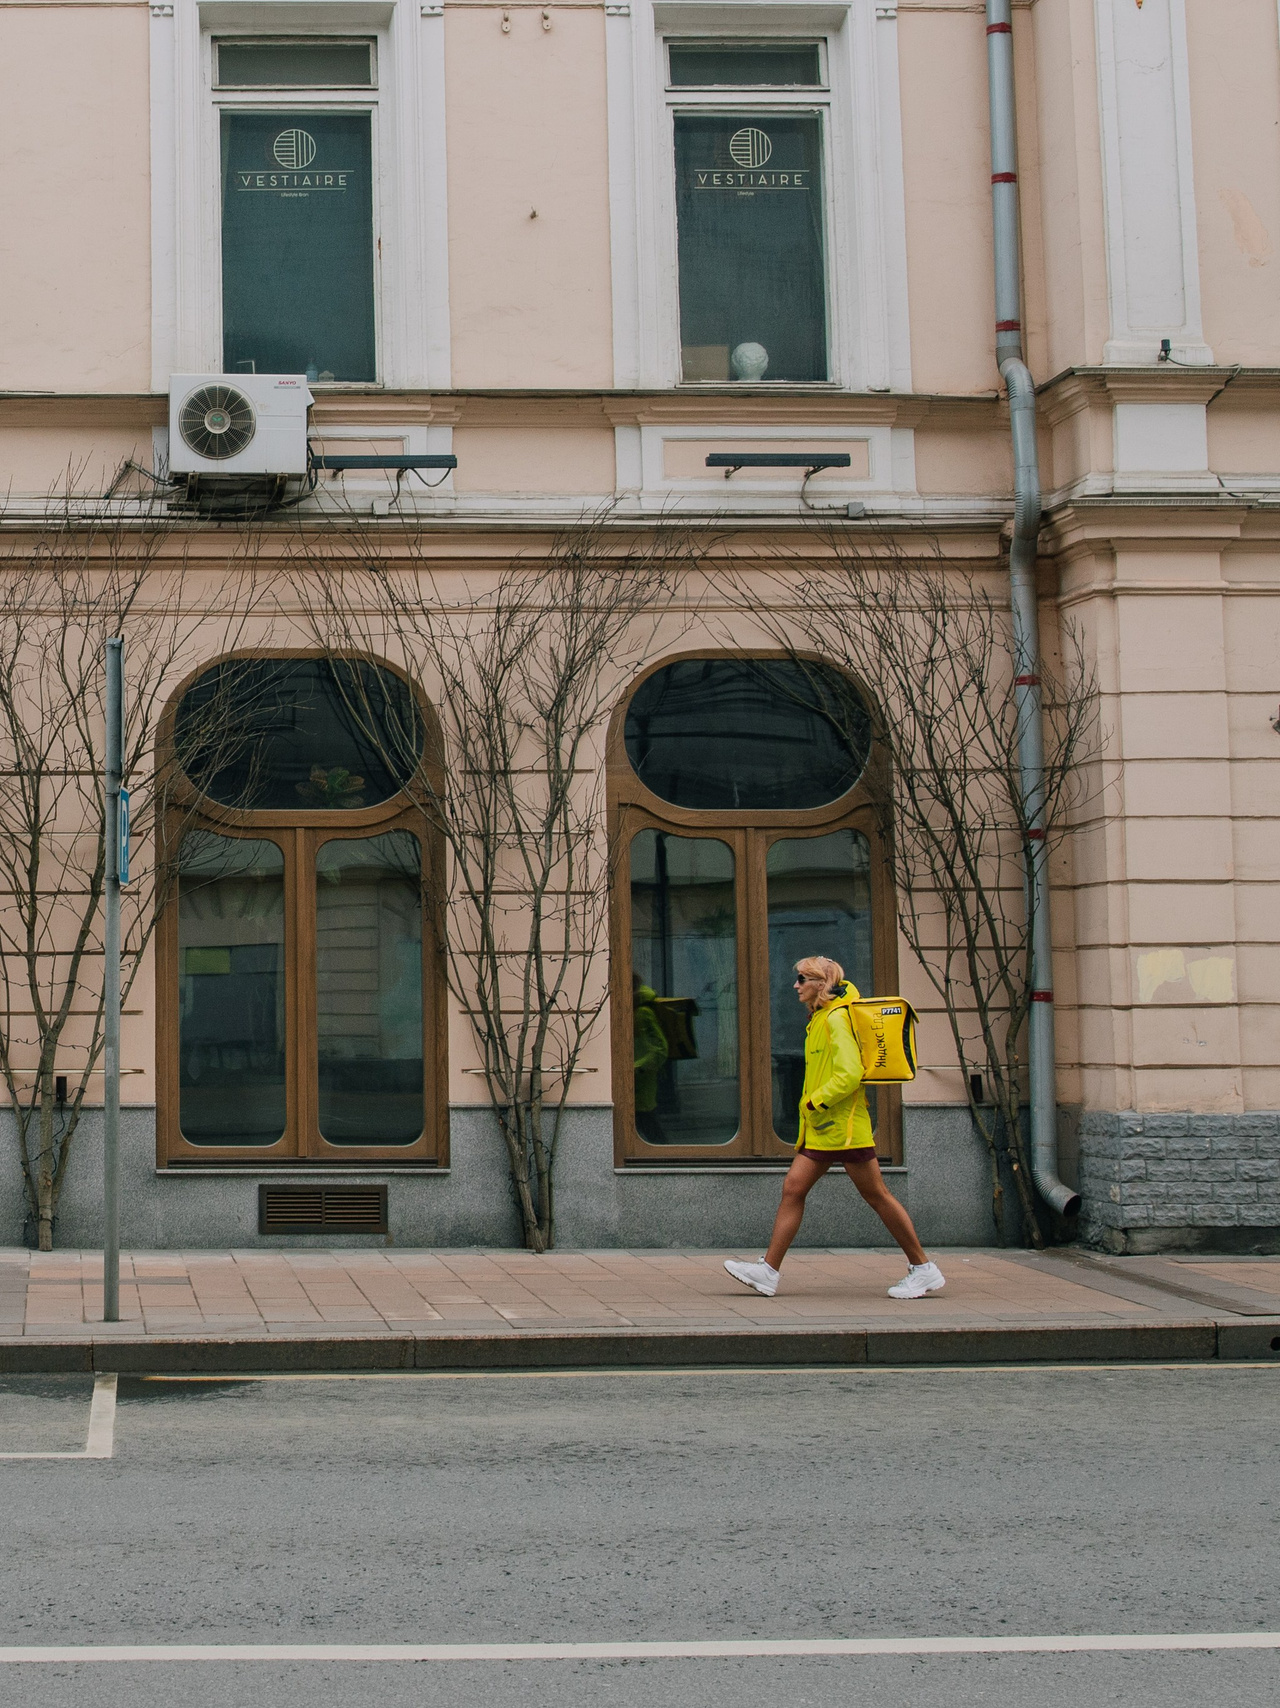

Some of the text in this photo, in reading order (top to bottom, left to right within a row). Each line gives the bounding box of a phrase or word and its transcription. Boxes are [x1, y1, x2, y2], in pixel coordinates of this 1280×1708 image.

[241, 175, 347, 187] VESTIAIRE
[698, 173, 802, 185] VESTIAIRE
[871, 1013, 887, 1068] Яндекс Еда
